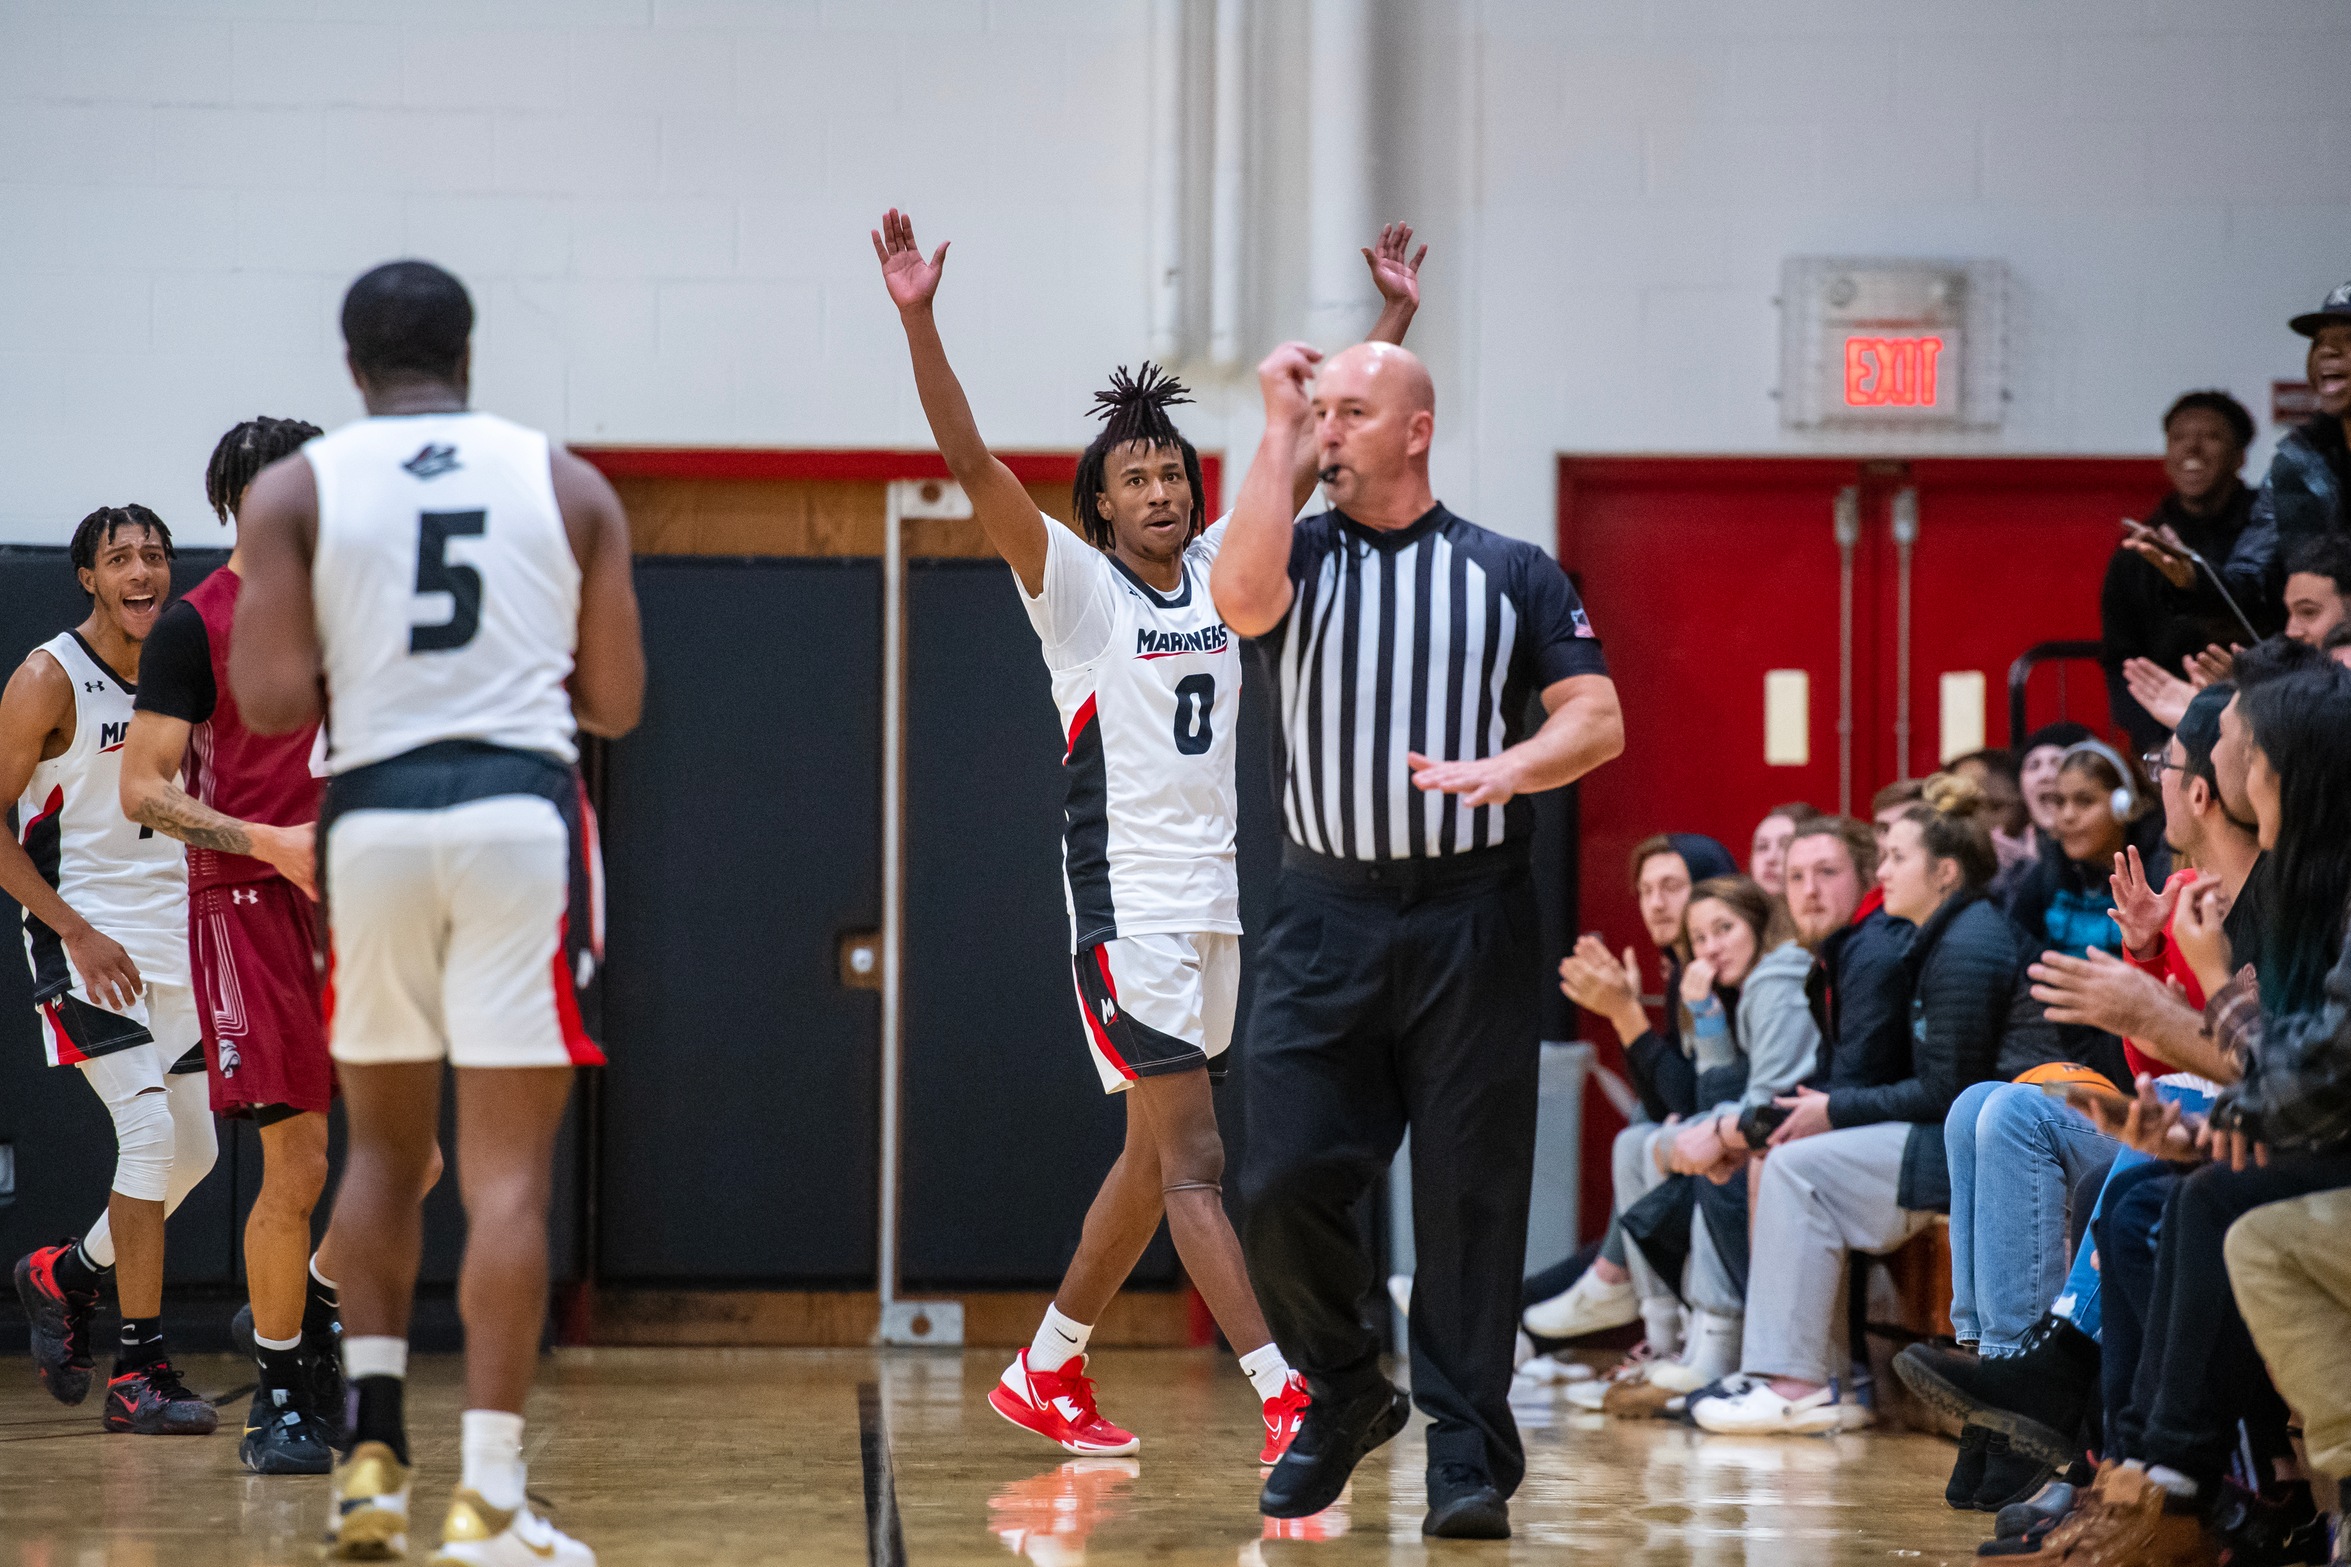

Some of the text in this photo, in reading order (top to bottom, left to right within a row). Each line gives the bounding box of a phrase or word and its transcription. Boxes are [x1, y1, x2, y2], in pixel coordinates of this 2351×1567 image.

[1845, 337, 1943, 406] EXIT
[410, 511, 487, 654] 5
[1136, 622, 1228, 654] MARINERS
[1173, 673, 1216, 756] 0
